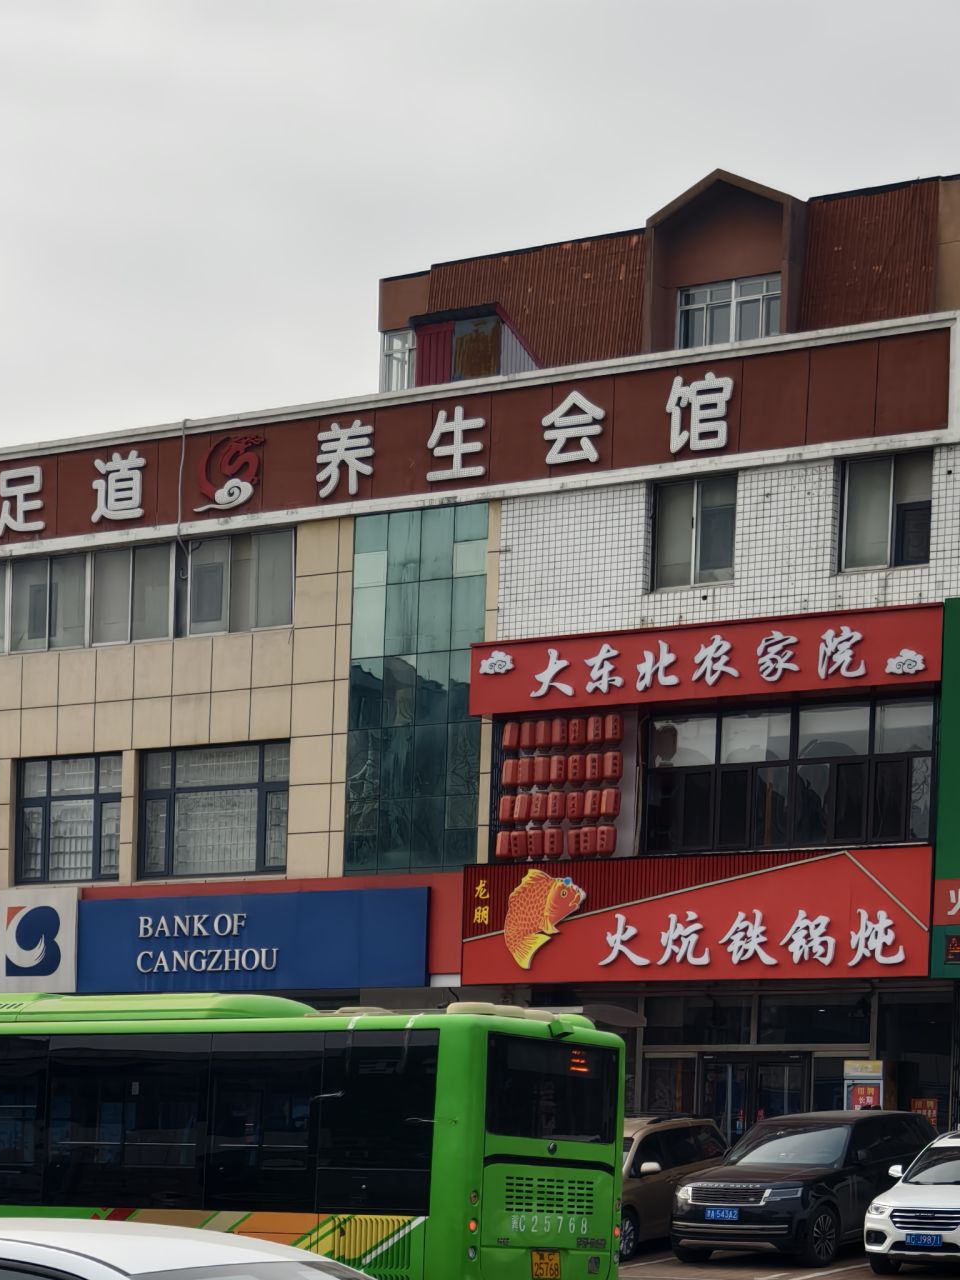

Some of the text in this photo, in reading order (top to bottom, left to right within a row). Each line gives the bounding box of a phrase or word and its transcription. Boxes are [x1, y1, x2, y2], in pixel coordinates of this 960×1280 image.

[315, 371, 734, 498] 养生会馆
[529, 626, 867, 698] 大东北农家院
[138, 912, 247, 939] BANK OF
[597, 908, 906, 968] 火炕铁锅炖
[136, 947, 279, 974] CANGZHOU
[534, 1262, 560, 1278] 25768
